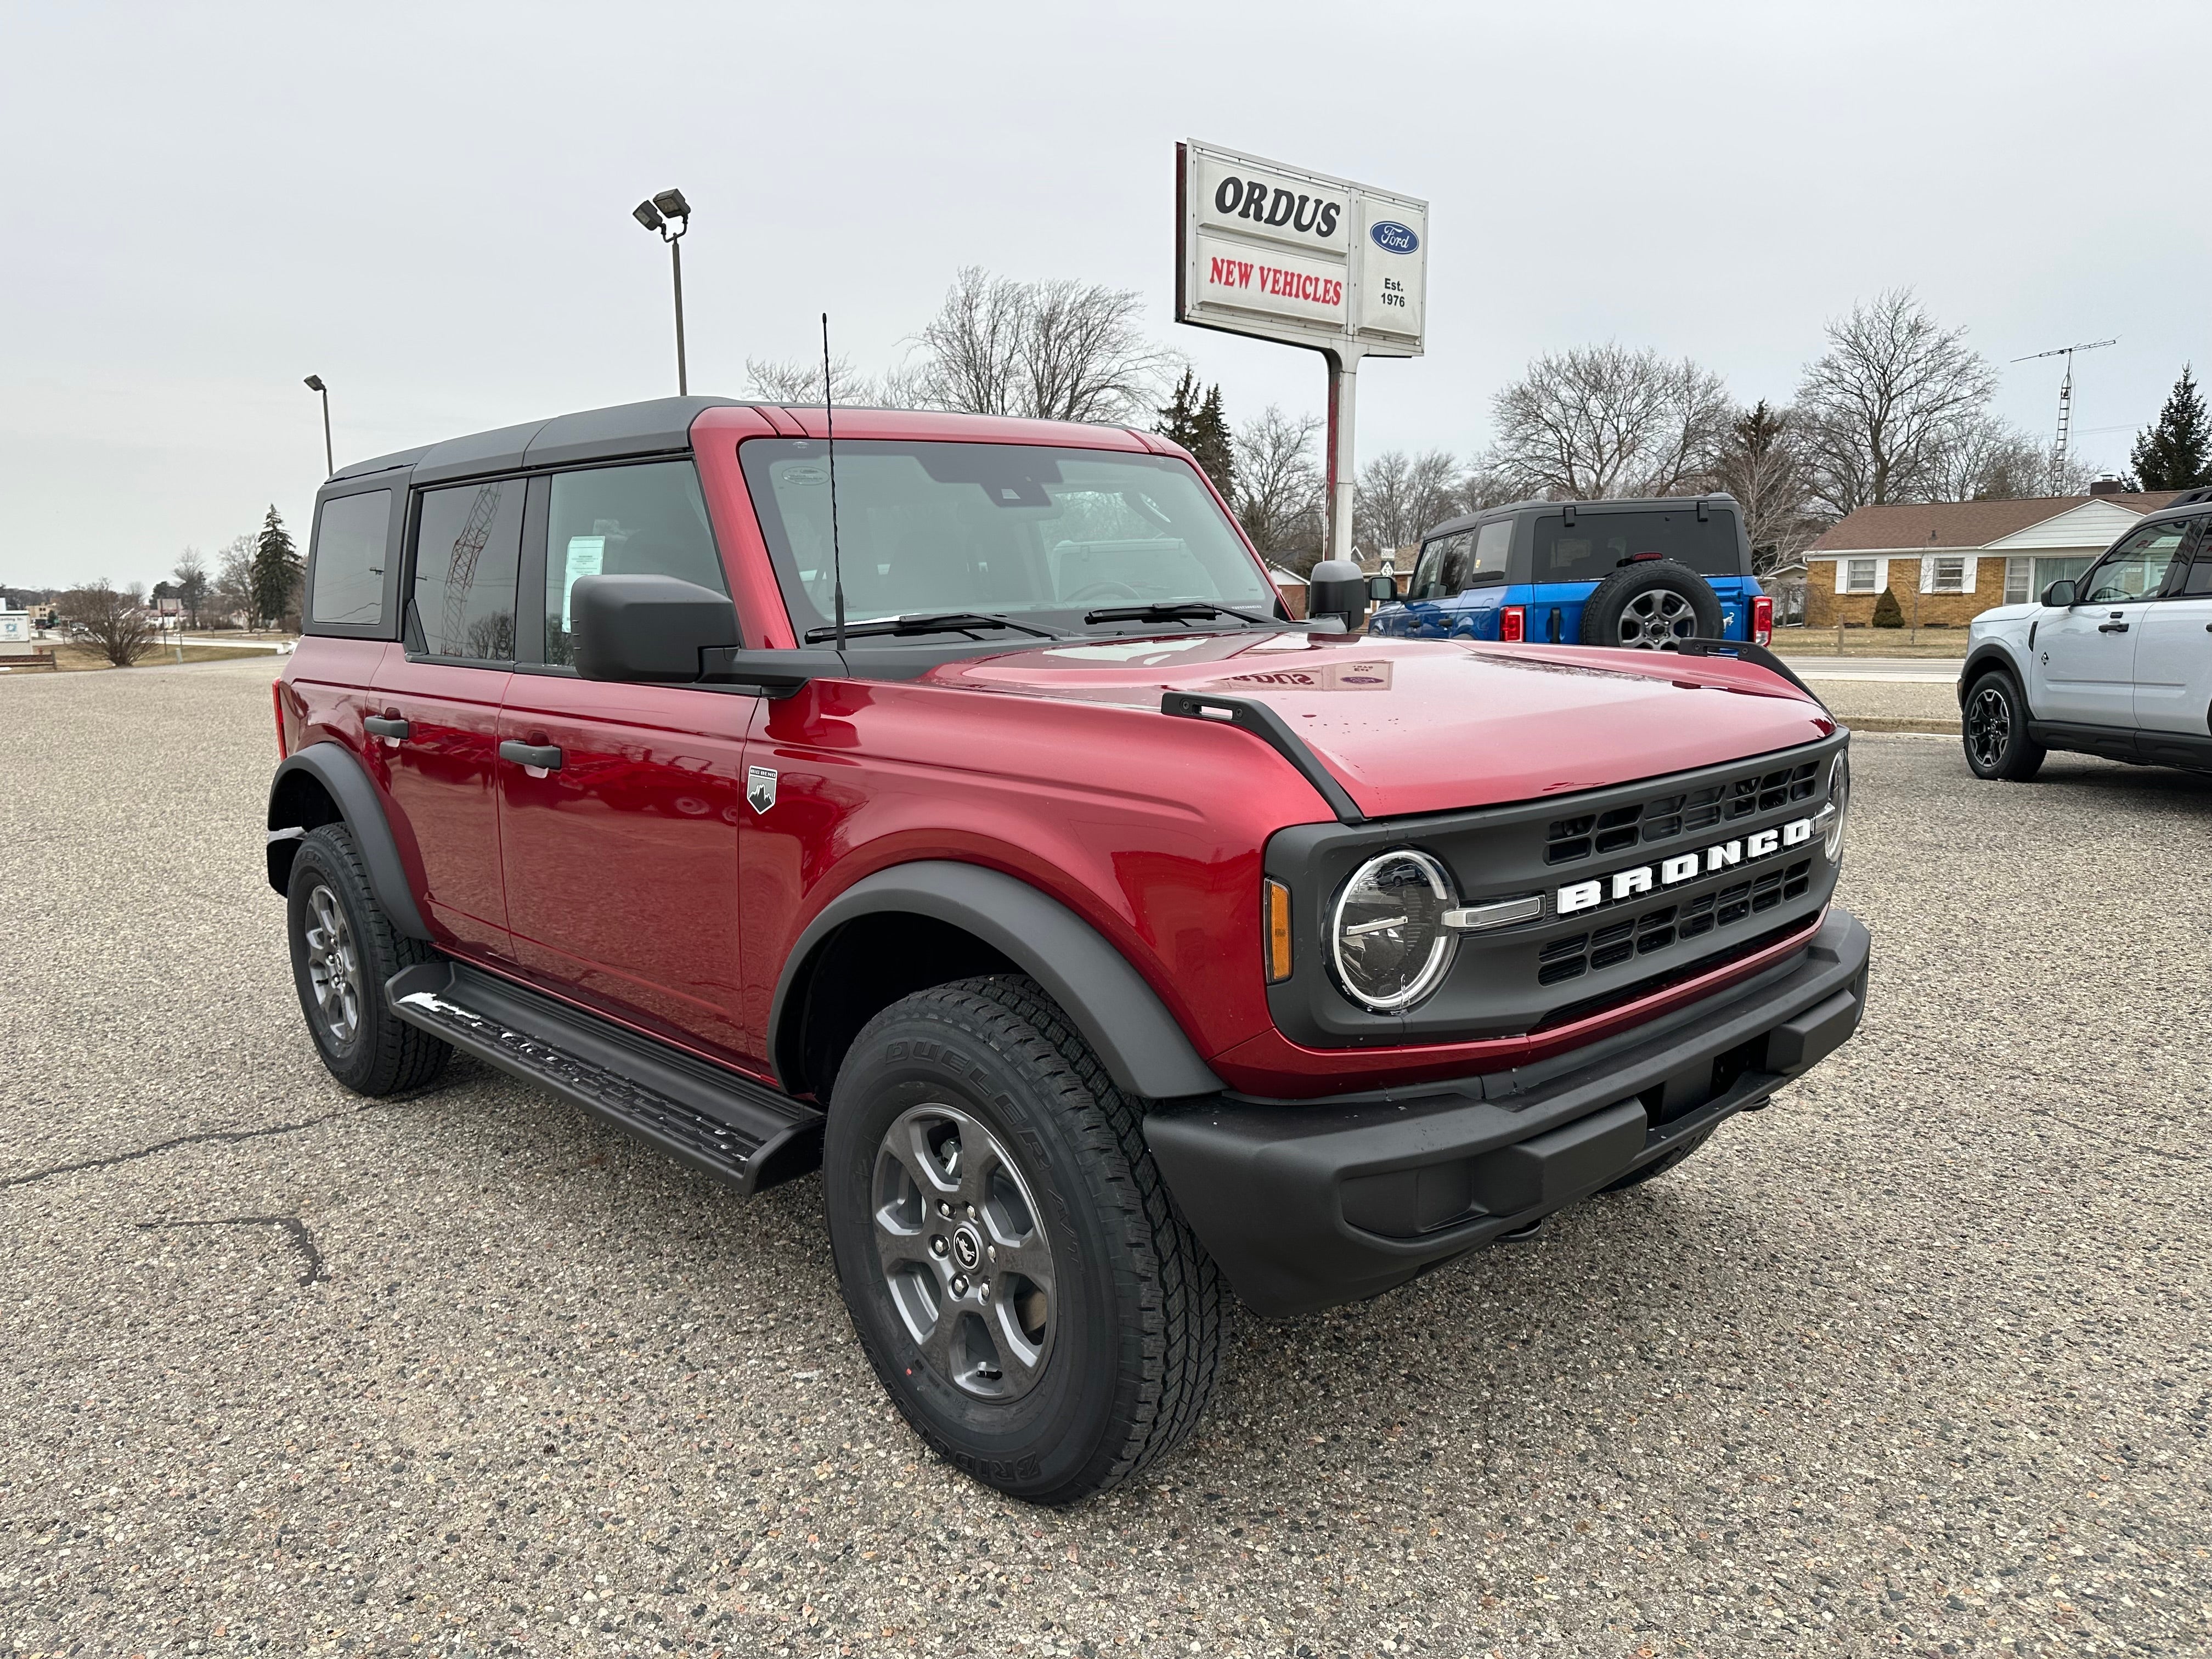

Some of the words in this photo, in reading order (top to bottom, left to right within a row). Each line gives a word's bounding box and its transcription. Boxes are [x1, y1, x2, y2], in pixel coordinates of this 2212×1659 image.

[1215, 176, 1341, 238] ORDUS
[1380, 225, 1410, 250] Ford
[1209, 257, 1254, 290] NEW
[1259, 266, 1342, 306] VEHICLES
[1384, 277, 1403, 292] Est.
[1381, 293, 1406, 308] 1976
[1384, 568, 1392, 577] 53
[1557, 818, 1811, 915] BRONCO
[884, 1037, 1054, 1172] DUELER
